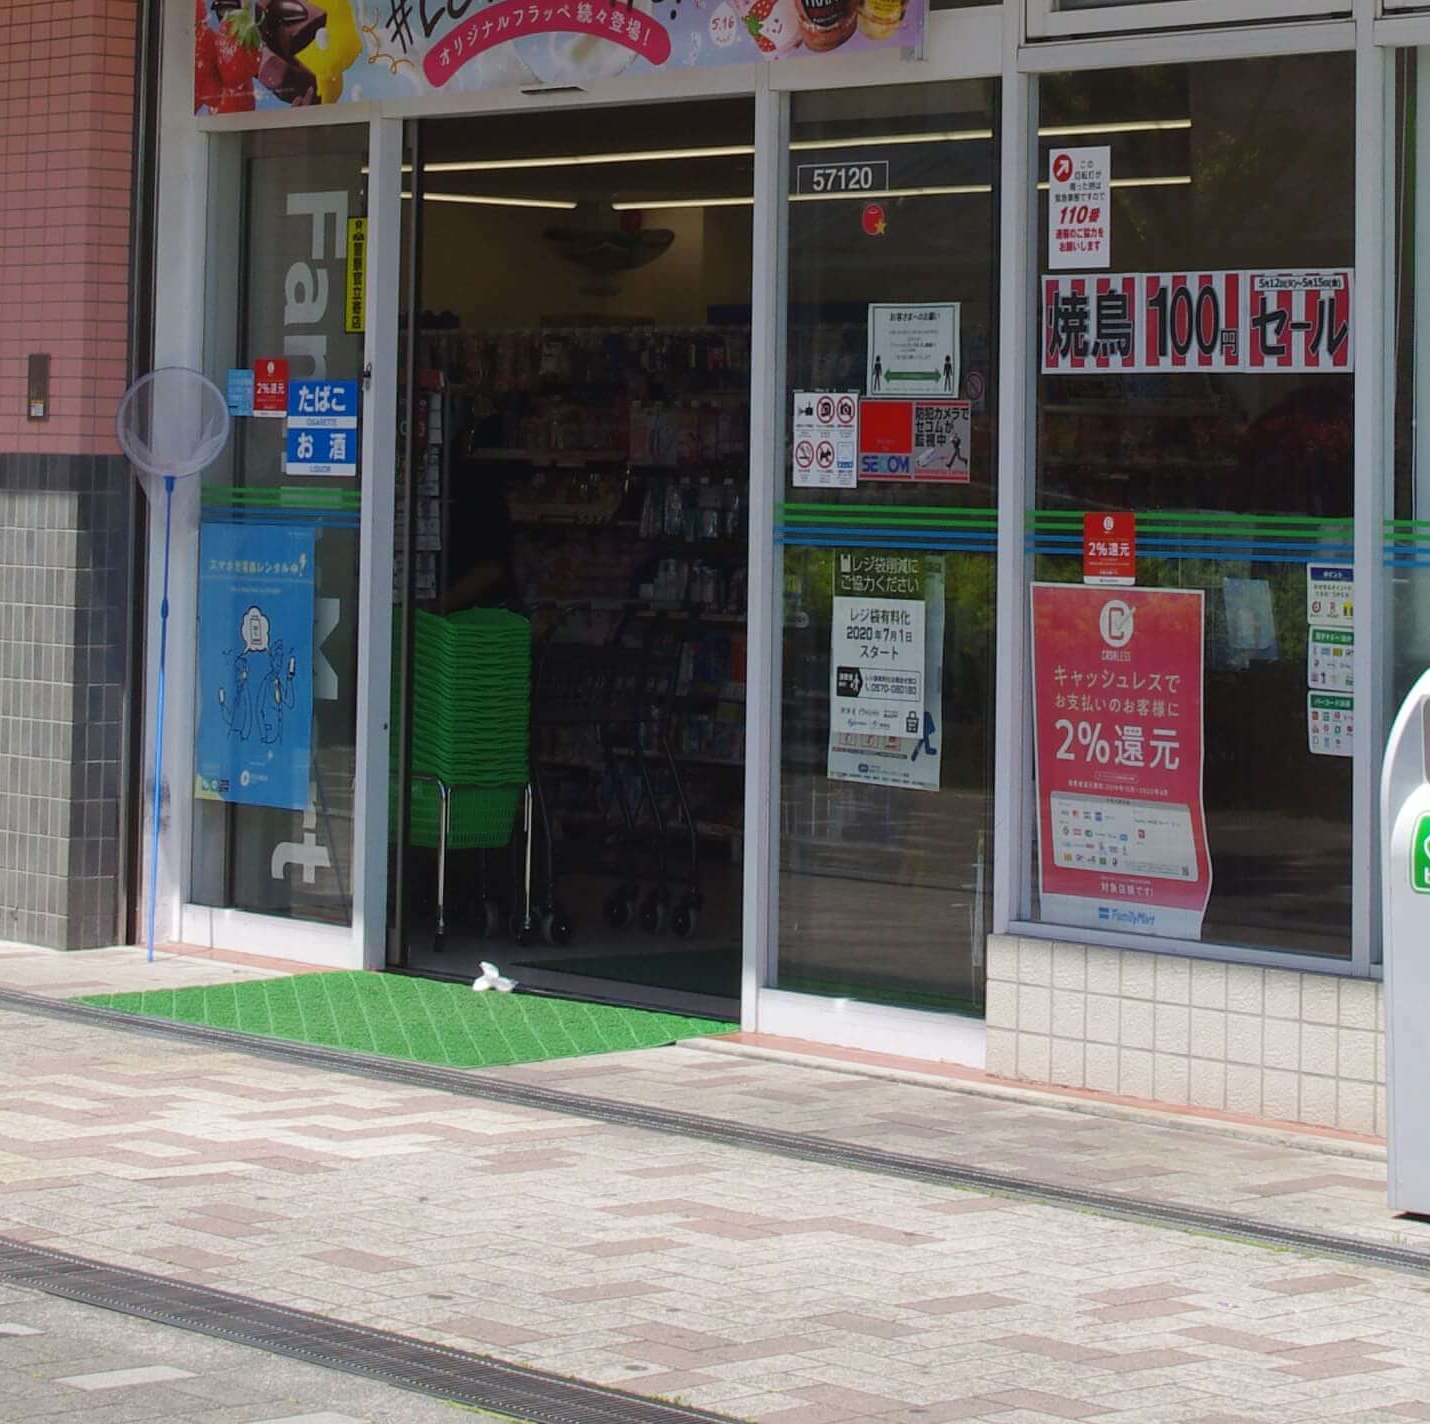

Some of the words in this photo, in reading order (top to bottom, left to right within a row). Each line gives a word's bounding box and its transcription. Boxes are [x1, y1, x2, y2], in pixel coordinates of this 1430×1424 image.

[812, 166, 873, 192] 57120
[1059, 205, 1101, 224] 110番
[1048, 289, 1132, 358] 焼鳥
[1148, 285, 1239, 358] 100円
[1251, 296, 1349, 356] セール
[298, 385, 347, 413] たばこ
[296, 431, 348, 461] お酒
[861, 455, 910, 473] SECOM
[841, 575, 920, 593] ご協力ください
[859, 645, 900, 661] スタート
[1054, 665, 1181, 693] キャッシュレスで
[1055, 693, 1180, 718] お支払いのお客様に
[1055, 719, 1180, 770] 2%還元
[1110, 908, 1156, 926] FamilyMart
